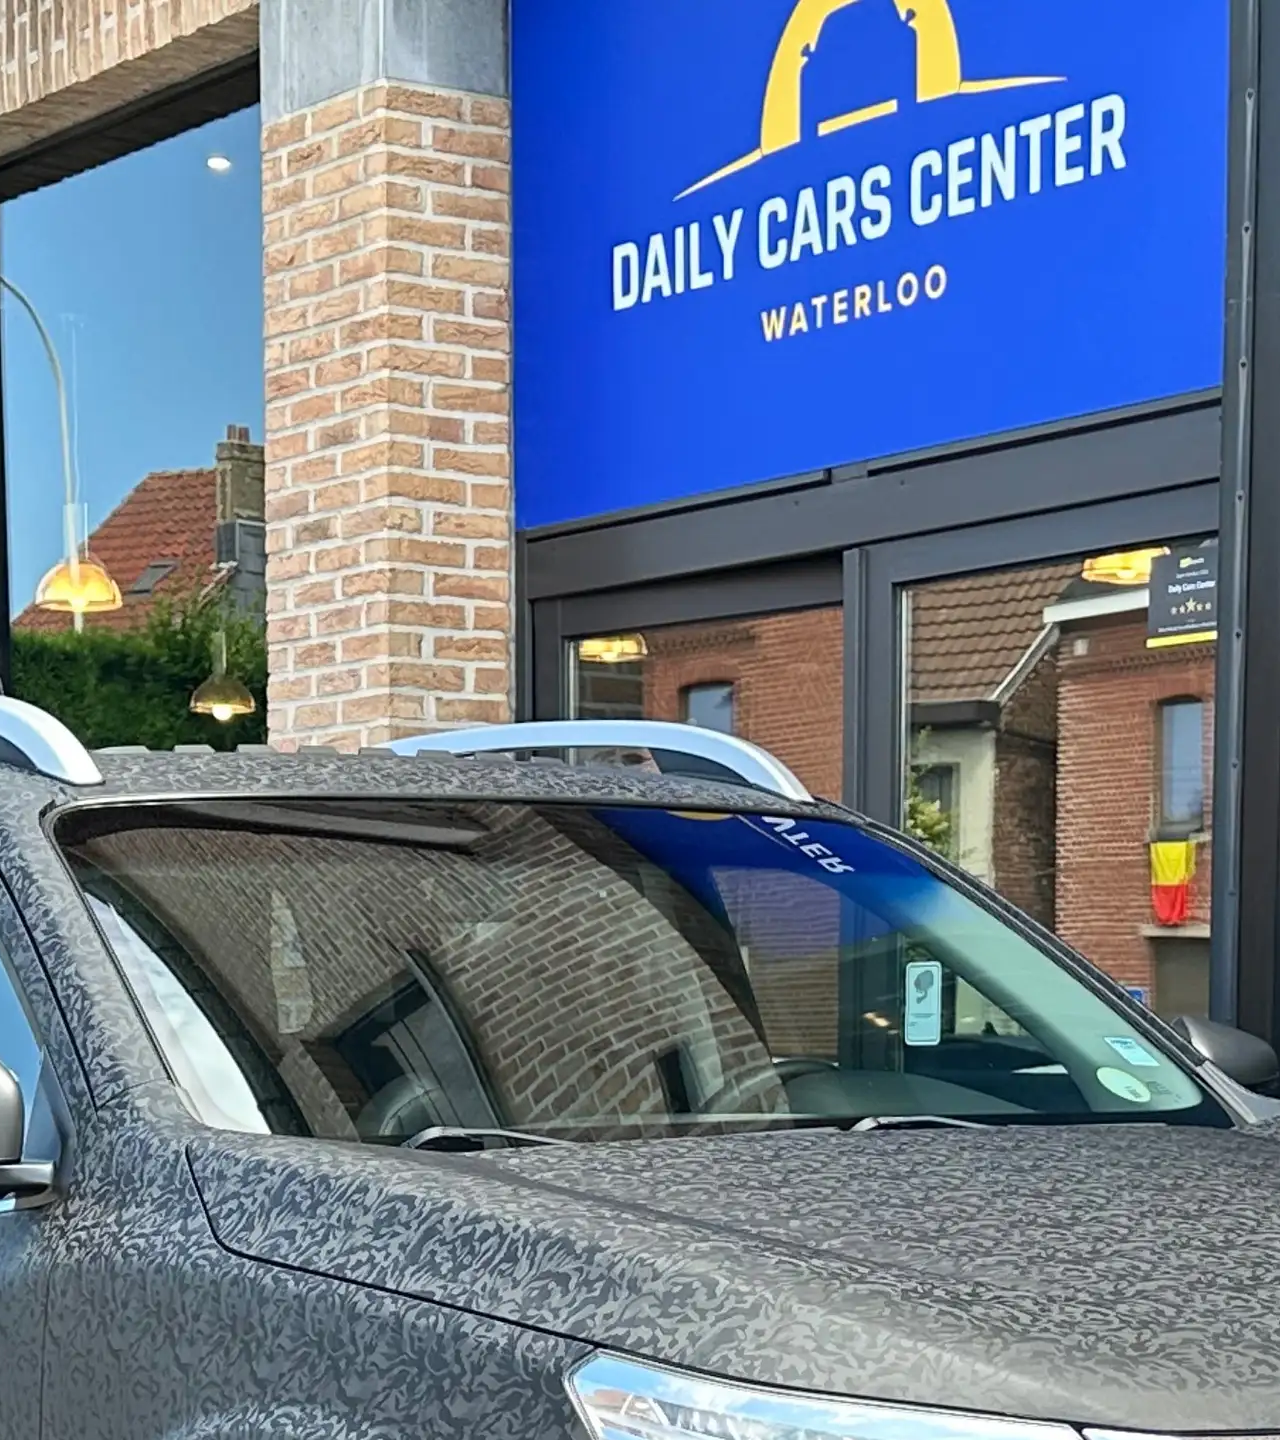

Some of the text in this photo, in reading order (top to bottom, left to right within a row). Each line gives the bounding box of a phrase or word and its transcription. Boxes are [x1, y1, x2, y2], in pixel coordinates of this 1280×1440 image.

[611, 92, 1128, 312] DAILY CARS CENTER
[759, 263, 949, 344] WATERLOO
